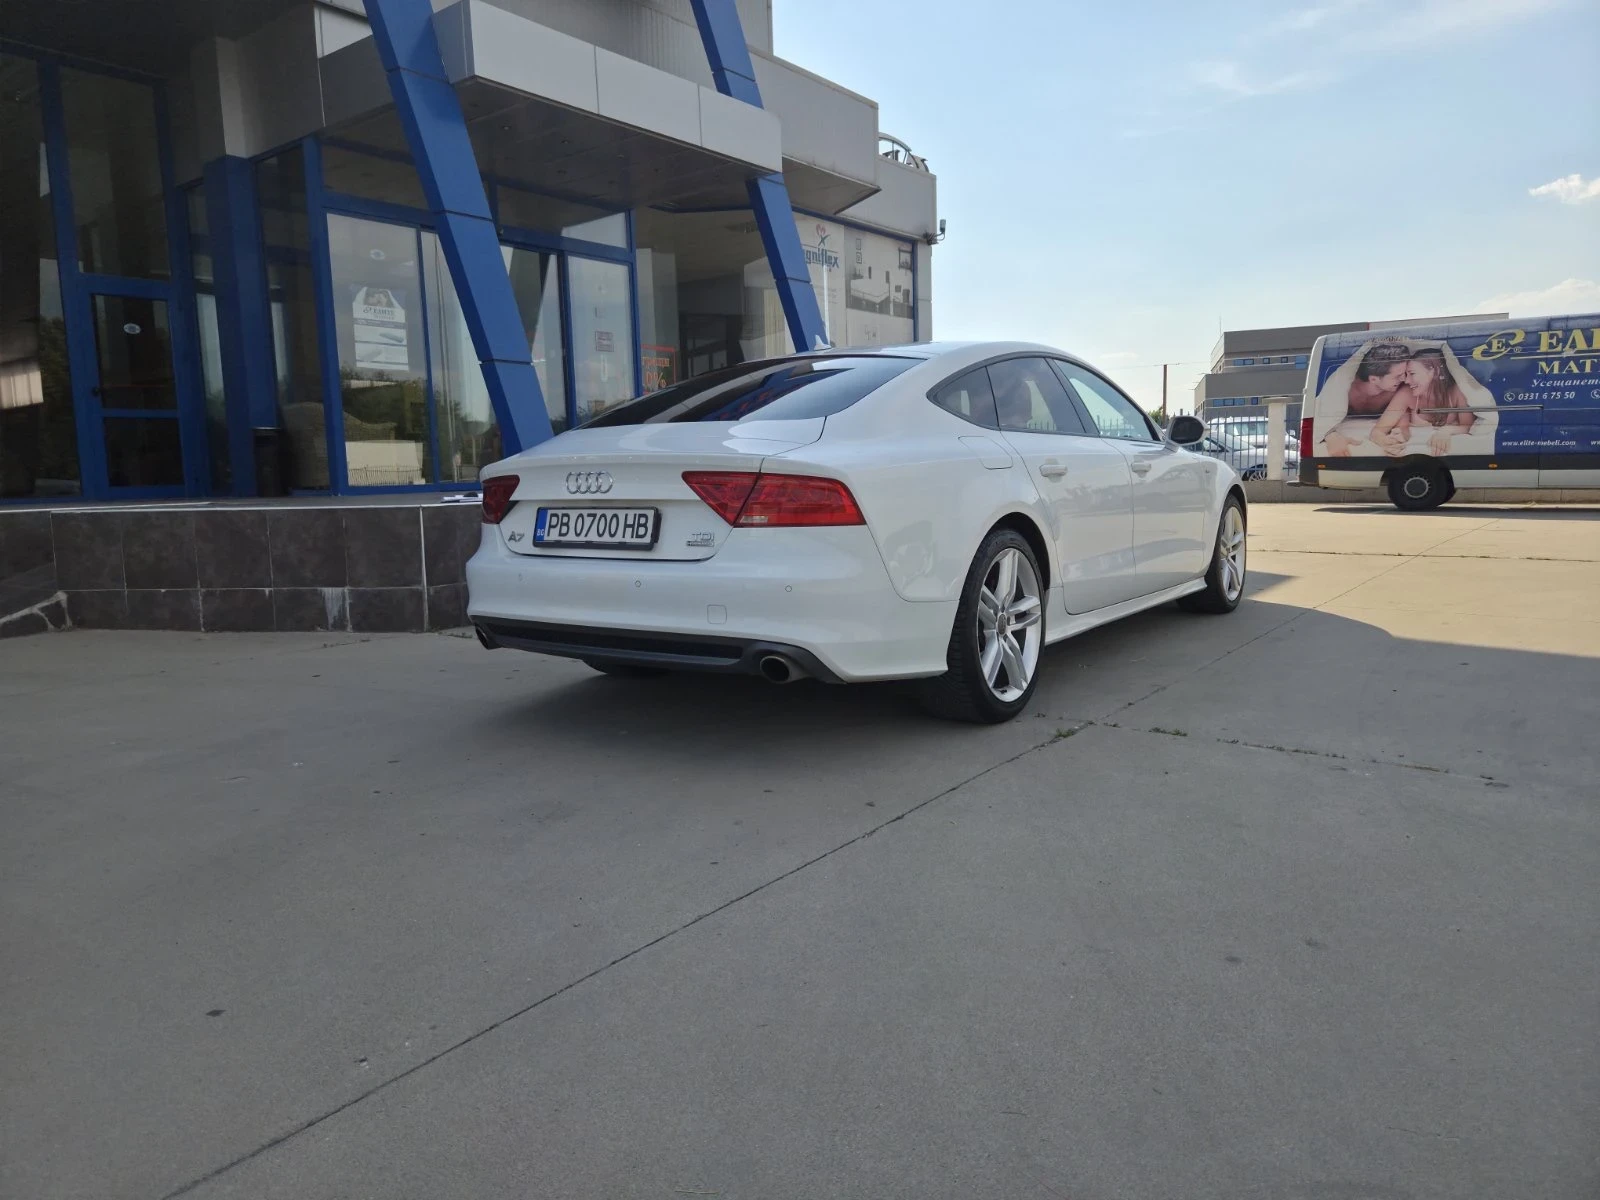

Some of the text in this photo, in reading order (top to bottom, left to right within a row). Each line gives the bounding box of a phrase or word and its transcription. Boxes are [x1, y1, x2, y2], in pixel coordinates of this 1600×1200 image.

[805, 248, 839, 268] gniflex
[1537, 359, 1600, 375] МАТ
[1532, 378, 1600, 388] Усещанет
[1518, 391, 1576, 400] 0331 6 75 50
[1502, 439, 1576, 447] www.elite-mebeli.com
[536, 513, 649, 539] BG PB 0700 HB
[508, 531, 525, 543] A7
